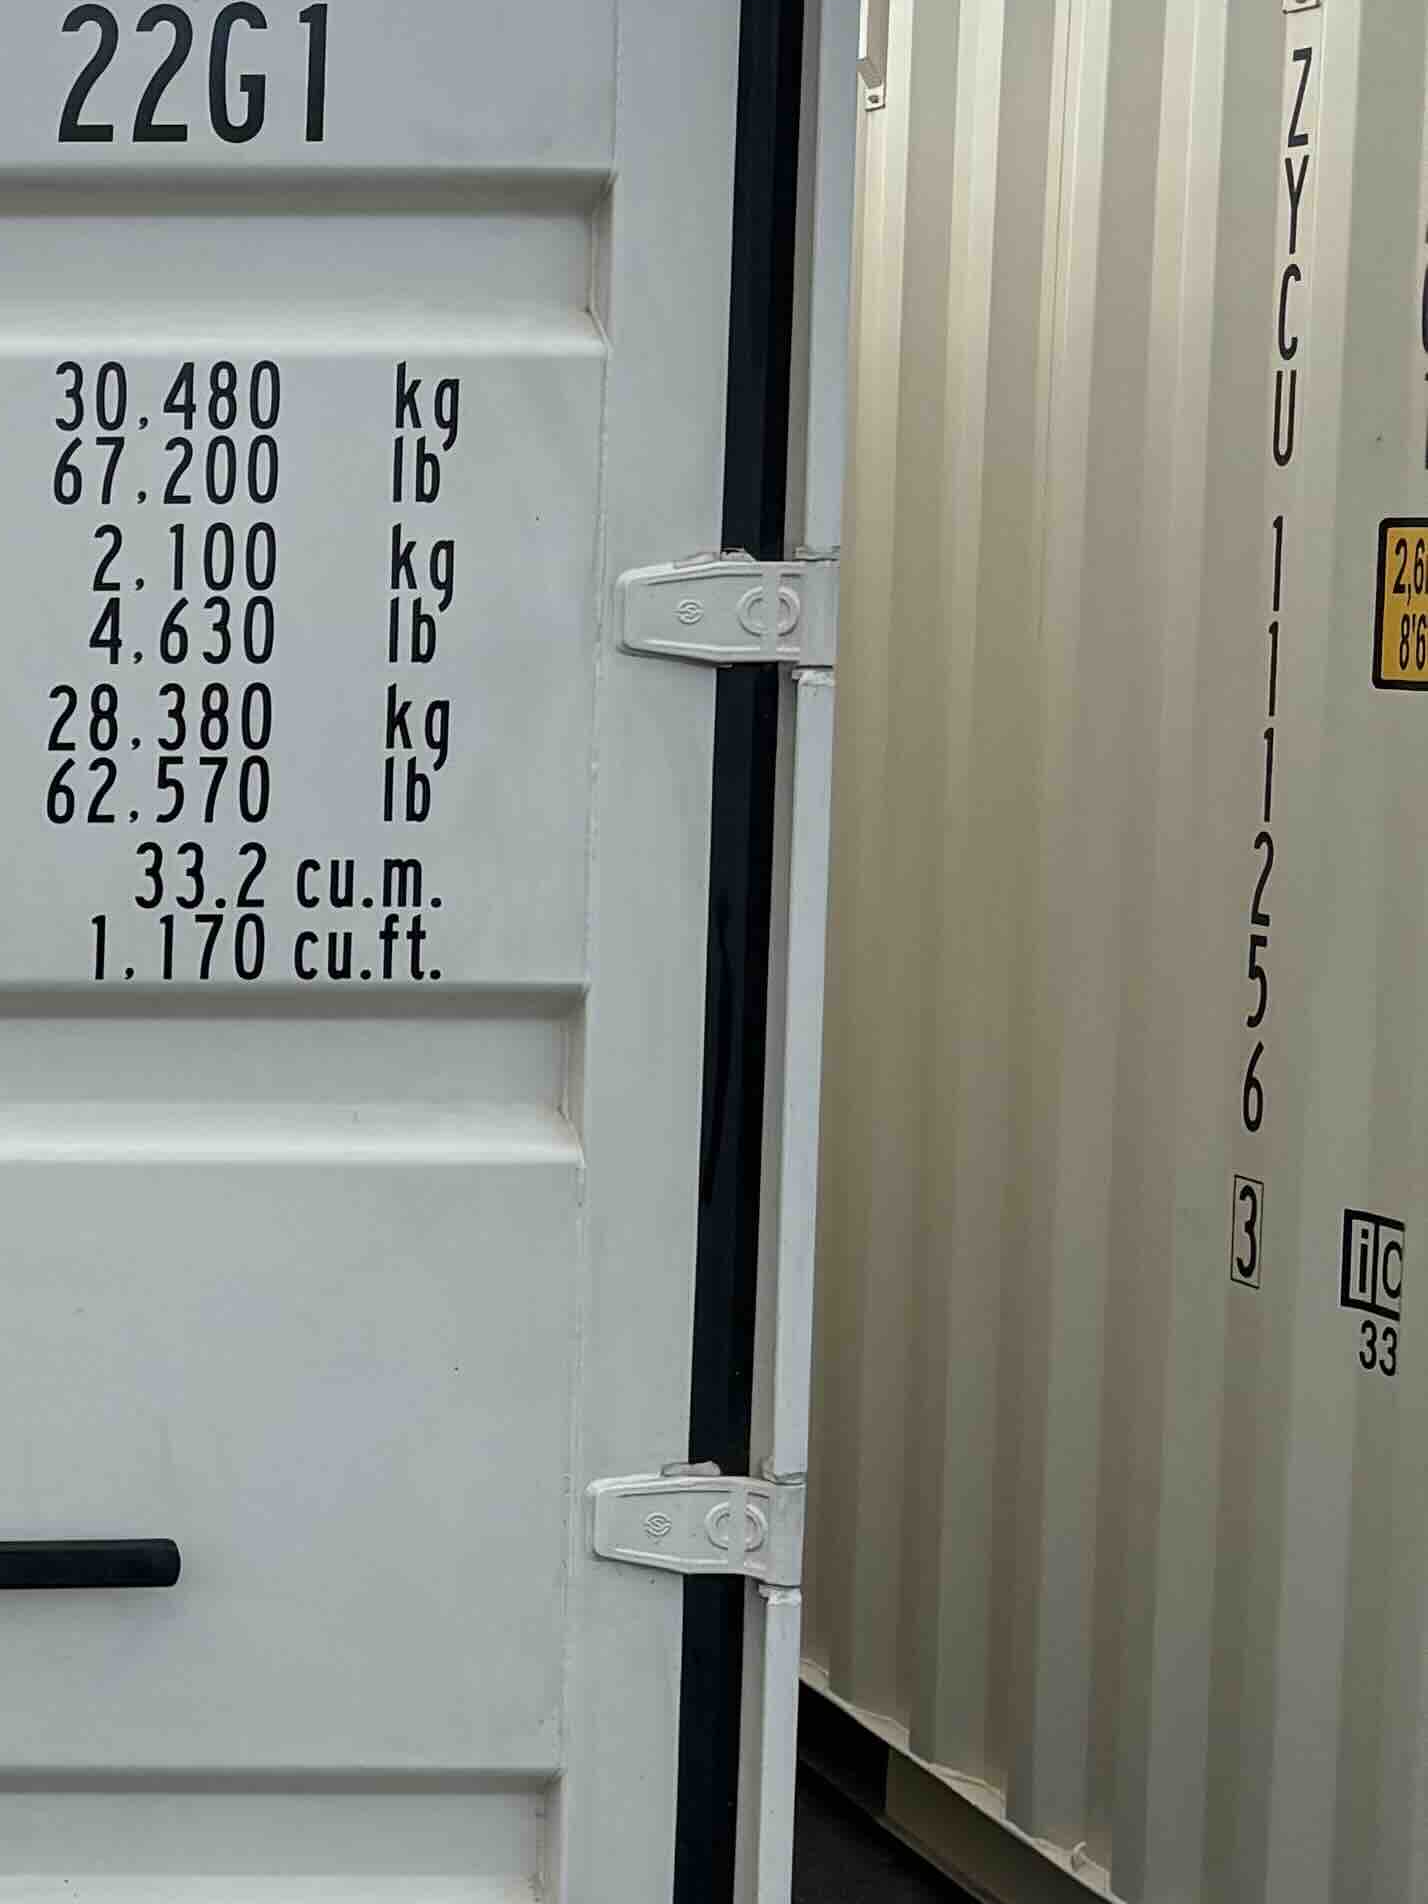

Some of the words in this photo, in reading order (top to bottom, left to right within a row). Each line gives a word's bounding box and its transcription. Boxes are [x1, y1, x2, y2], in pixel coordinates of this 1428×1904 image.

[59, 2, 328, 143] 22G1
[1272, 47, 1312, 466] ZYCU
[55, 360, 281, 431] 30,480
[395, 361, 460, 452] kg
[53, 435, 279, 504] 67,200
[392, 436, 441, 503] lb
[92, 522, 277, 591] 2,100
[390, 522, 455, 612] kg
[1392, 537, 1428, 606] 2,6
[88, 595, 275, 665] 4,630
[388, 596, 437, 663] lb
[47, 682, 272, 751] 28,380
[385, 683, 450, 772] kg
[46, 755, 270, 824] 62,570
[383, 755, 431, 823] lb
[1242, 517, 1286, 1134] 111256
[135, 842, 267, 909] 33.2
[297, 858, 442, 908] cu.m.
[91, 913, 265, 980] 1,170
[294, 914, 441, 980] cu.ft.
[1235, 1185, 1257, 1279] 3
[1359, 1317, 1399, 1377] 33
